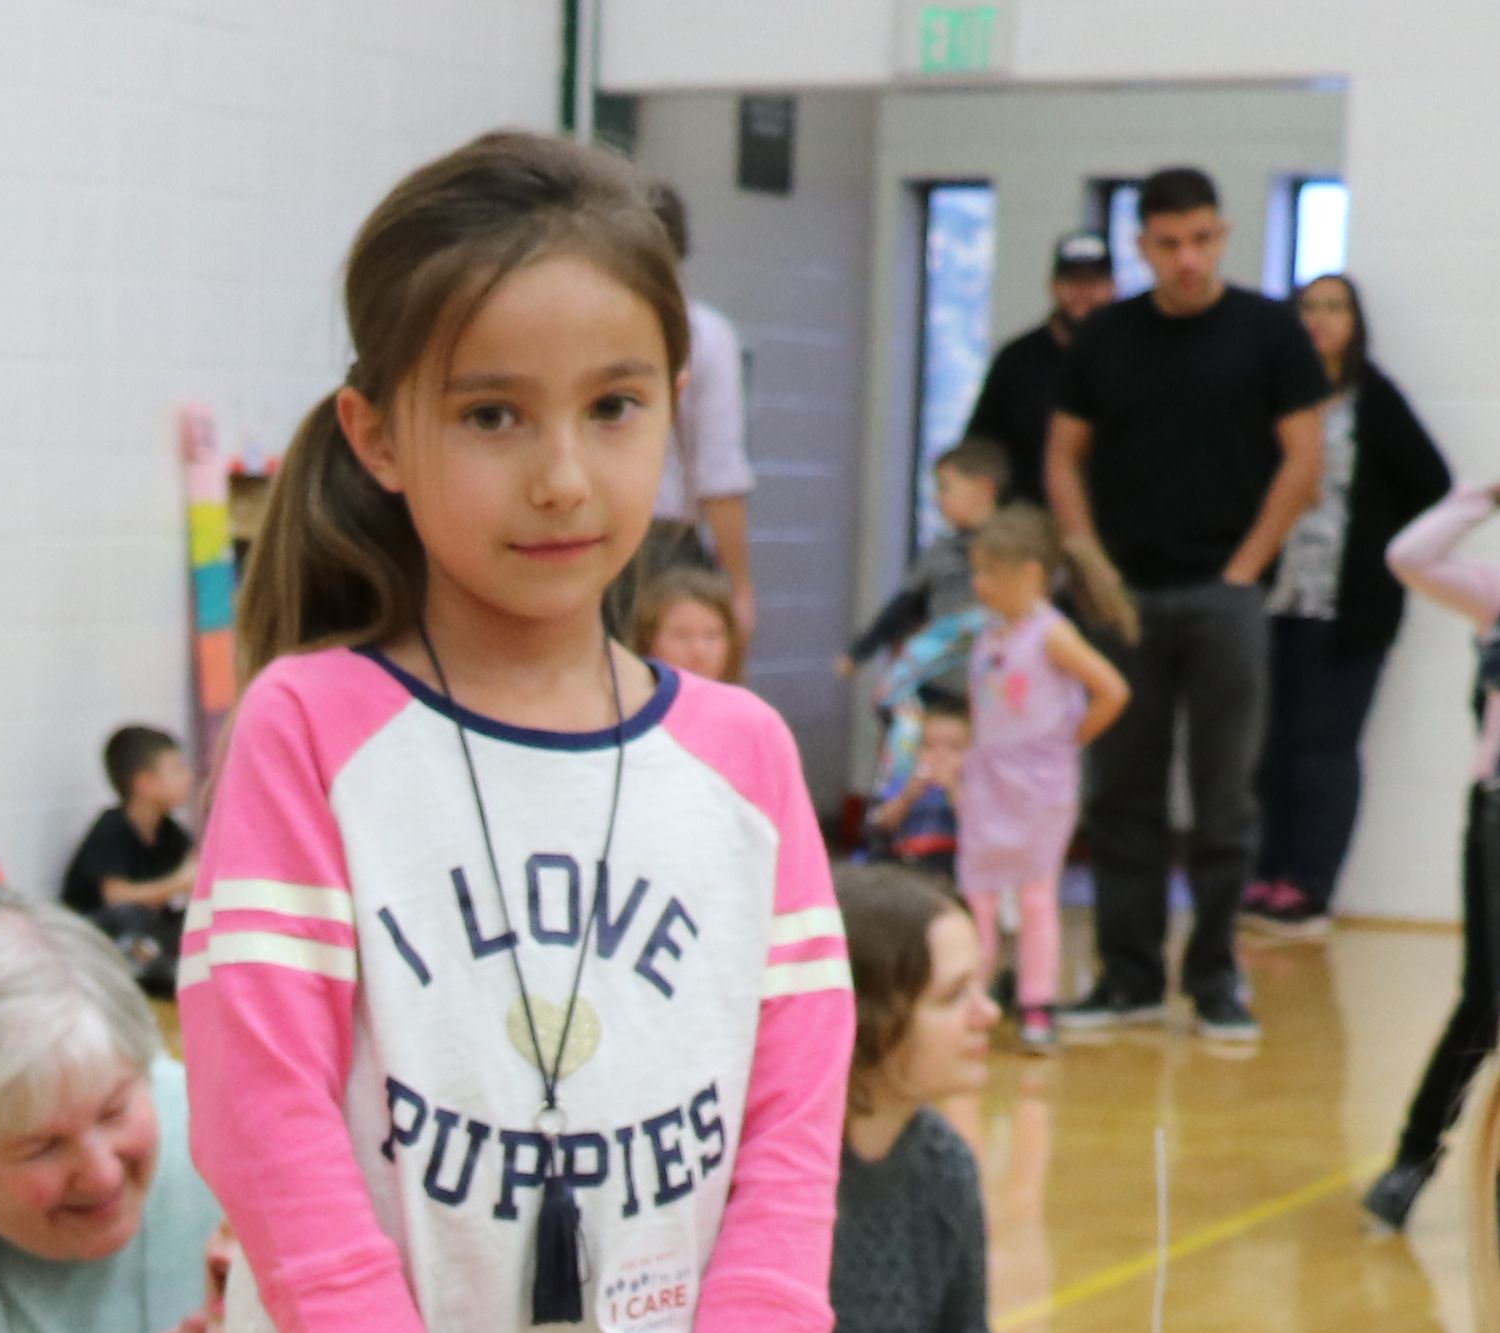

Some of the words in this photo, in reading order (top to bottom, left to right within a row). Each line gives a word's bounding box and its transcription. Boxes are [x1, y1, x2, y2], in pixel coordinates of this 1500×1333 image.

[377, 906, 432, 987] I
[450, 853, 698, 999] LOVE
[381, 1076, 728, 1220] PUPPIES
[610, 1301, 618, 1323] I
[626, 1284, 687, 1320] CARE
